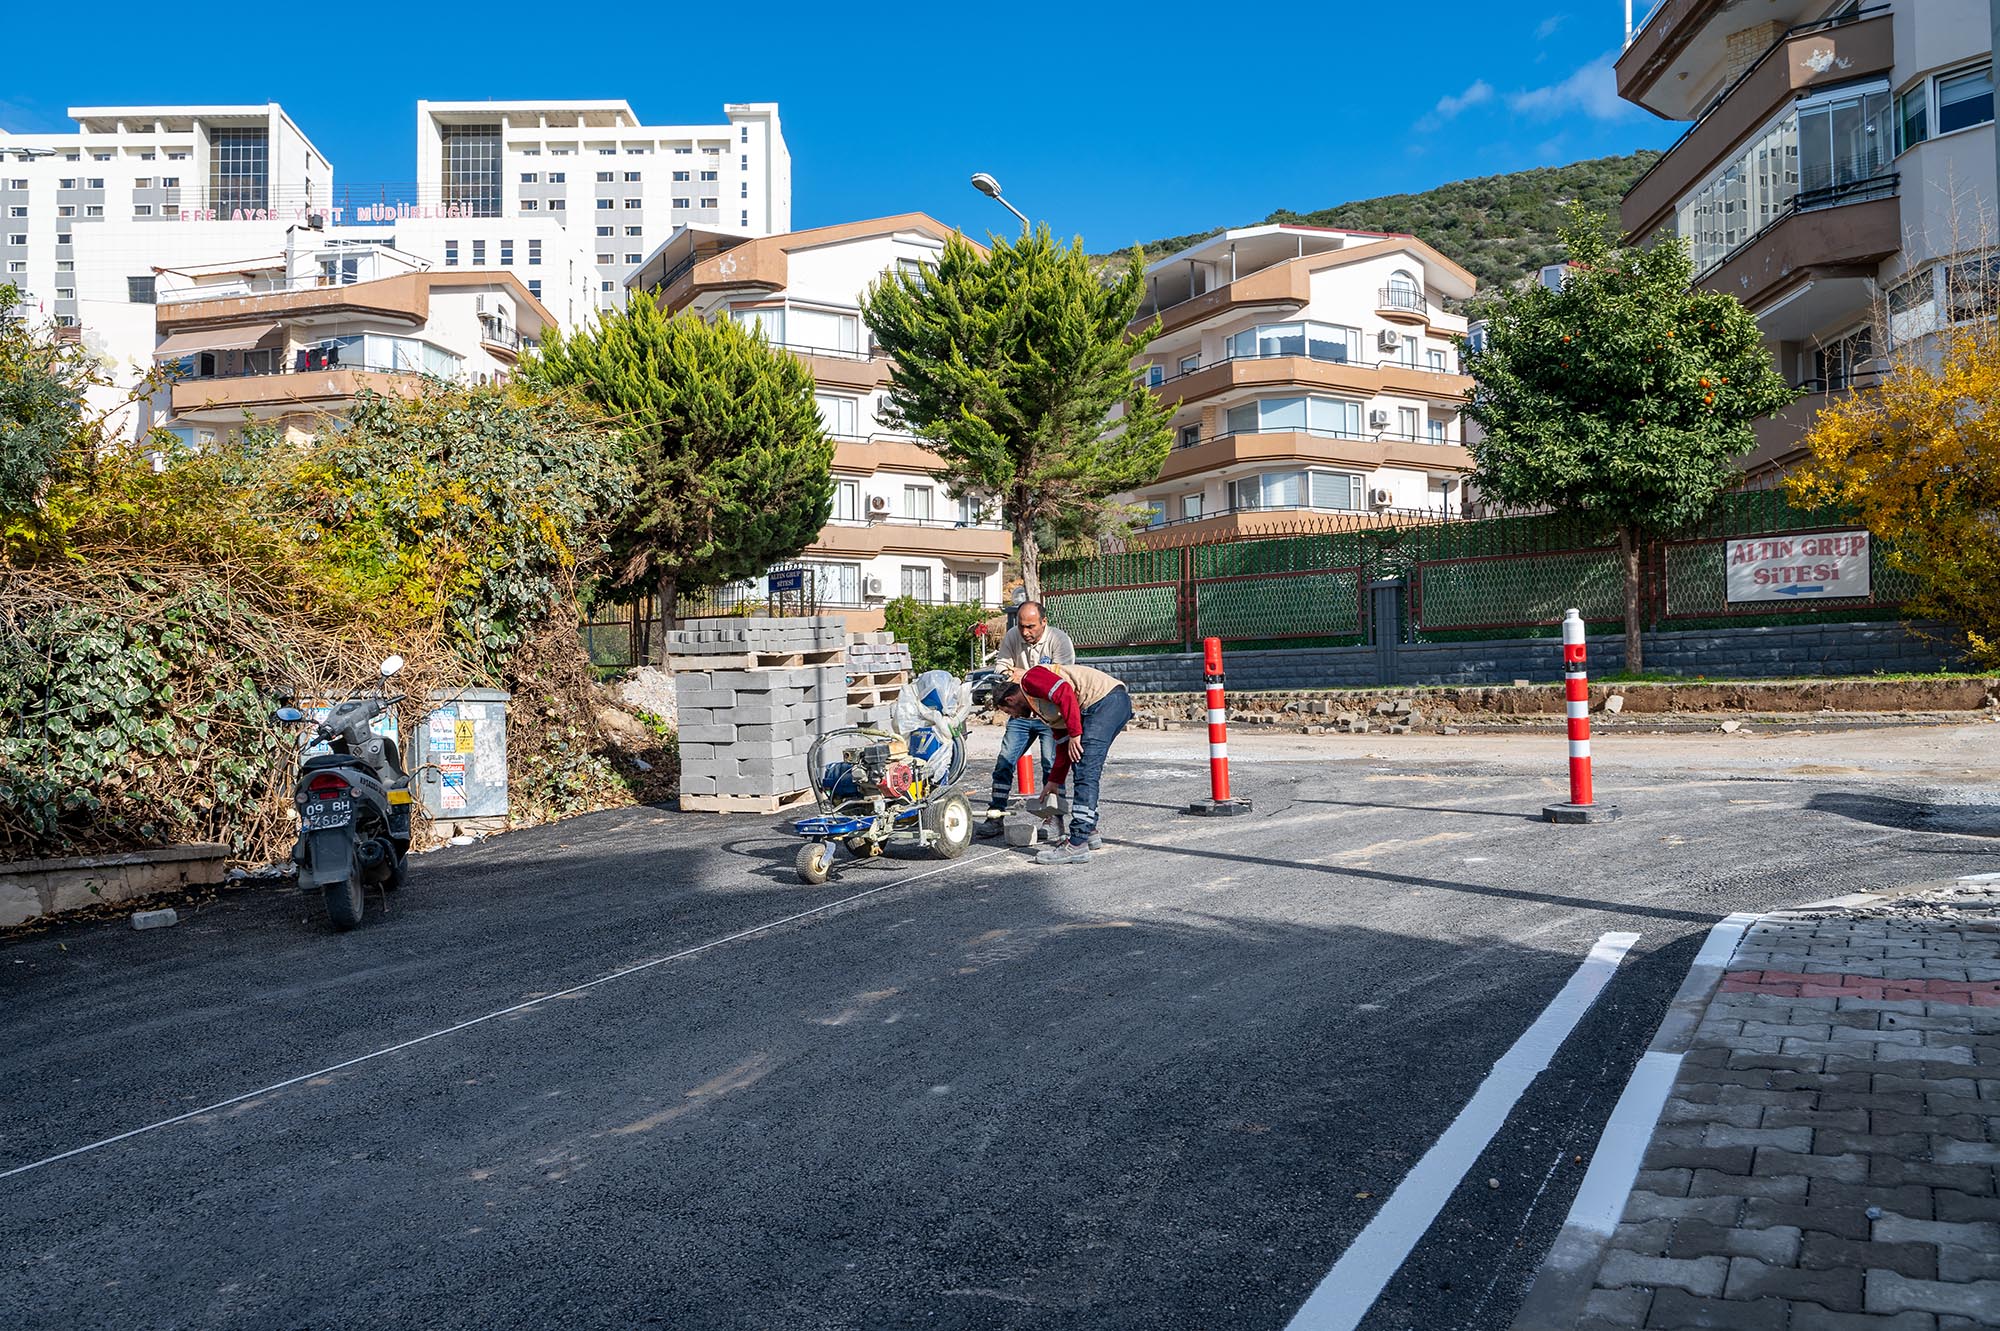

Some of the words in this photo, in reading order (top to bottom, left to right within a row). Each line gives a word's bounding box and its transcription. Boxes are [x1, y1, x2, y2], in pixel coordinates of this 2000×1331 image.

[1732, 540, 1794, 566] ALTIN
[1801, 535, 1866, 558] GRUP
[306, 803, 325, 816] 09
[332, 800, 350, 812] BH
